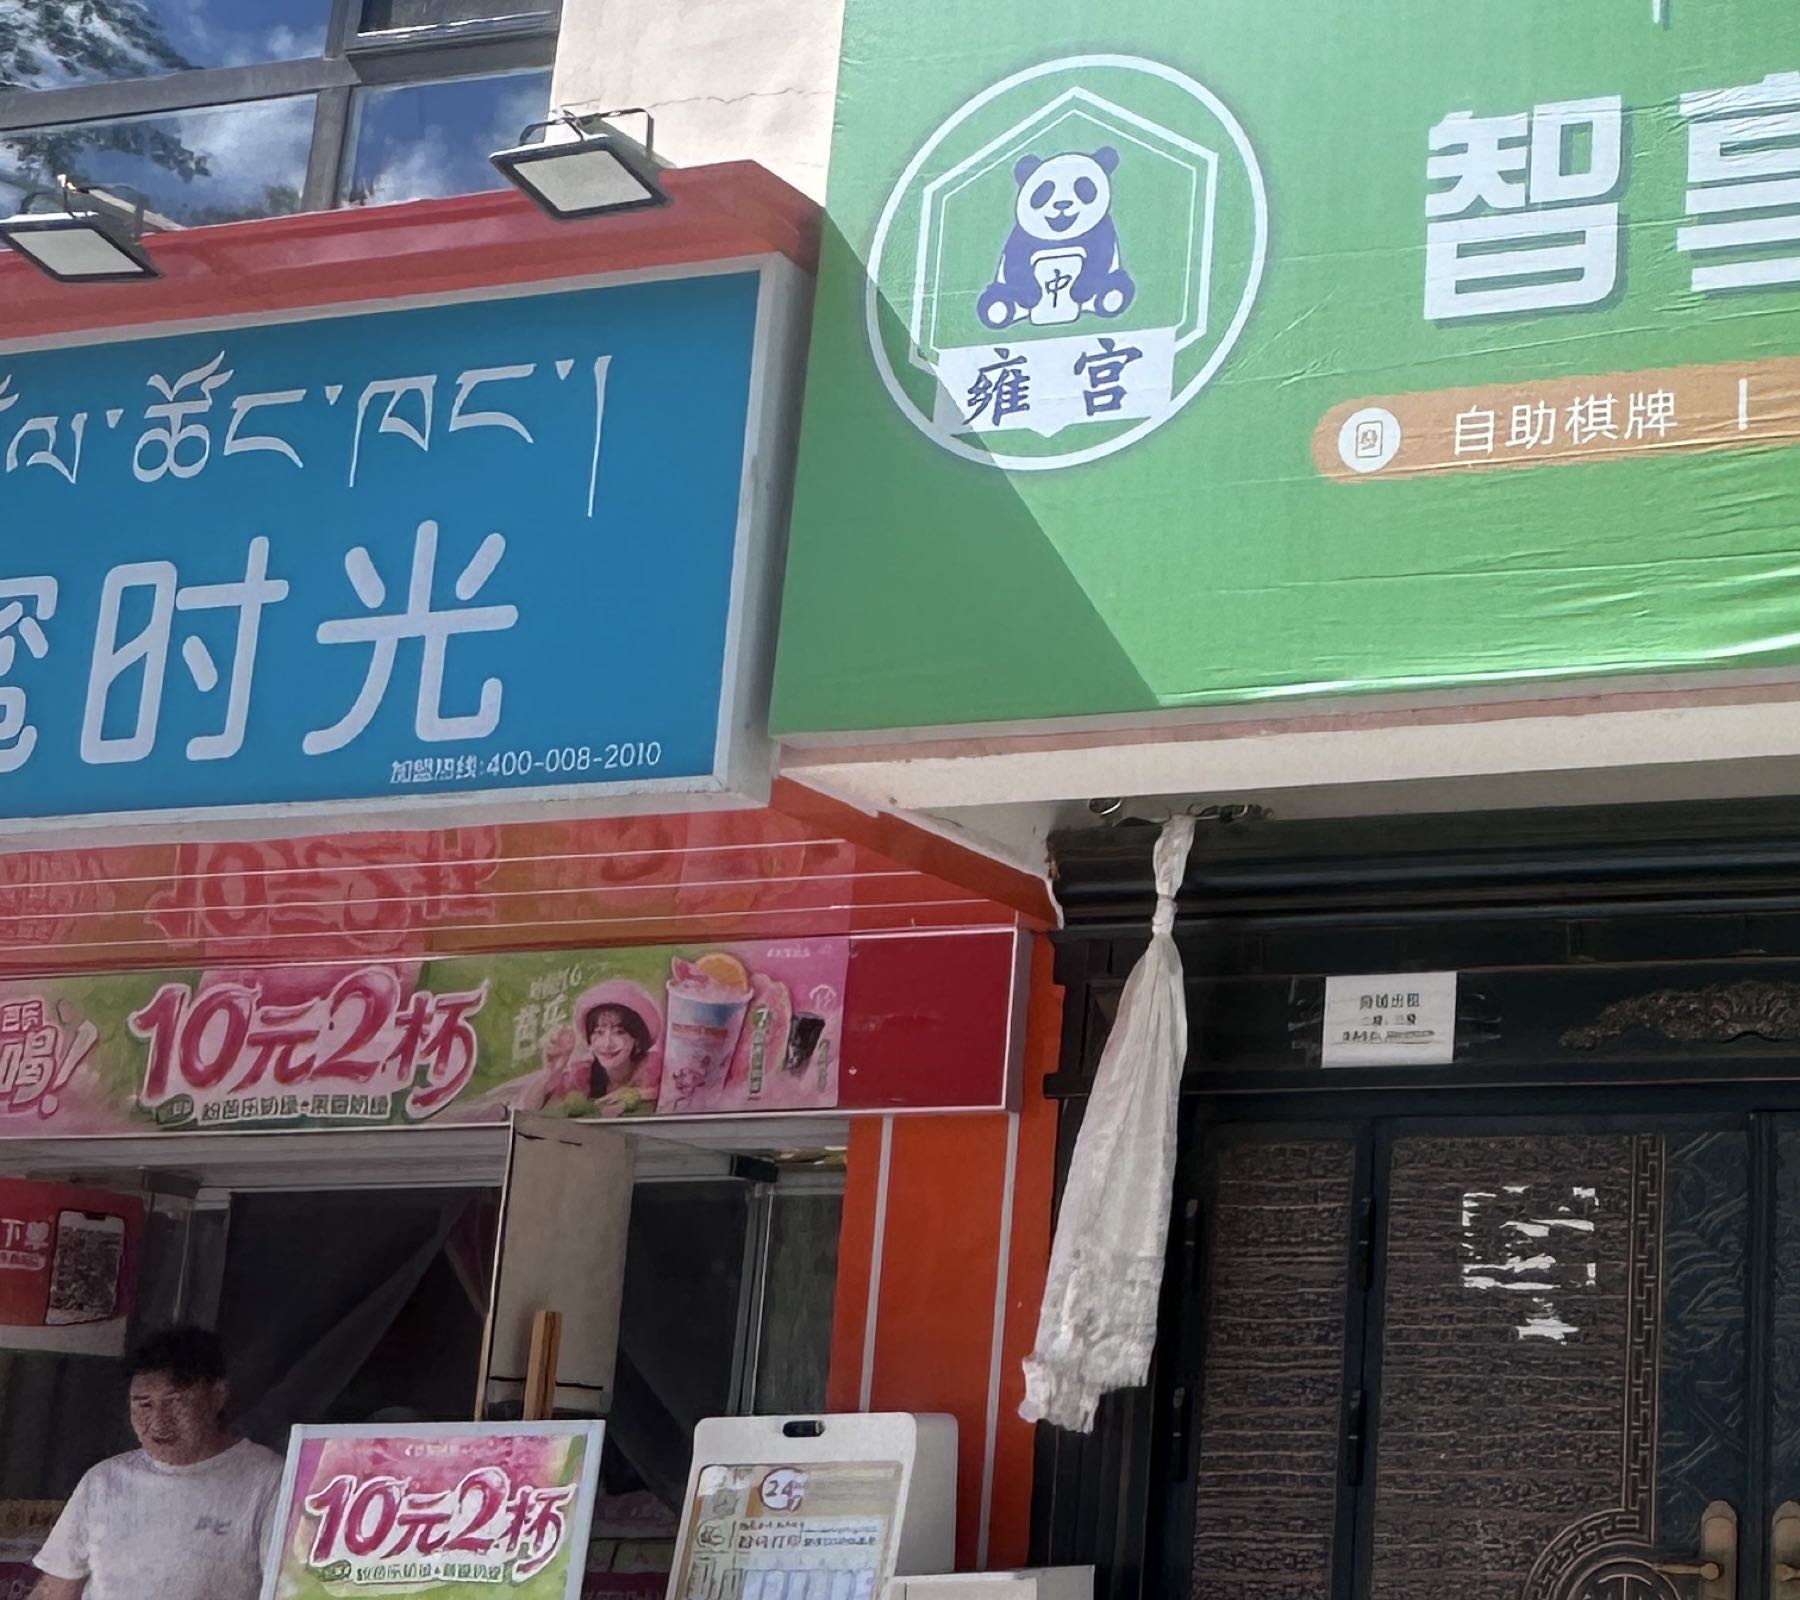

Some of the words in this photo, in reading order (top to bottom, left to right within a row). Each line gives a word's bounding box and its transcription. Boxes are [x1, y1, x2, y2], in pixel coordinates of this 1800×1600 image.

[1045, 268, 1073, 308] 中
[966, 337, 1144, 428] 雍宫
[1452, 388, 1679, 457] 自助棋牌
[0, 518, 520, 773] 时光
[133, 970, 486, 1116] 10元2杯
[307, 1467, 577, 1580] 10元2杯
